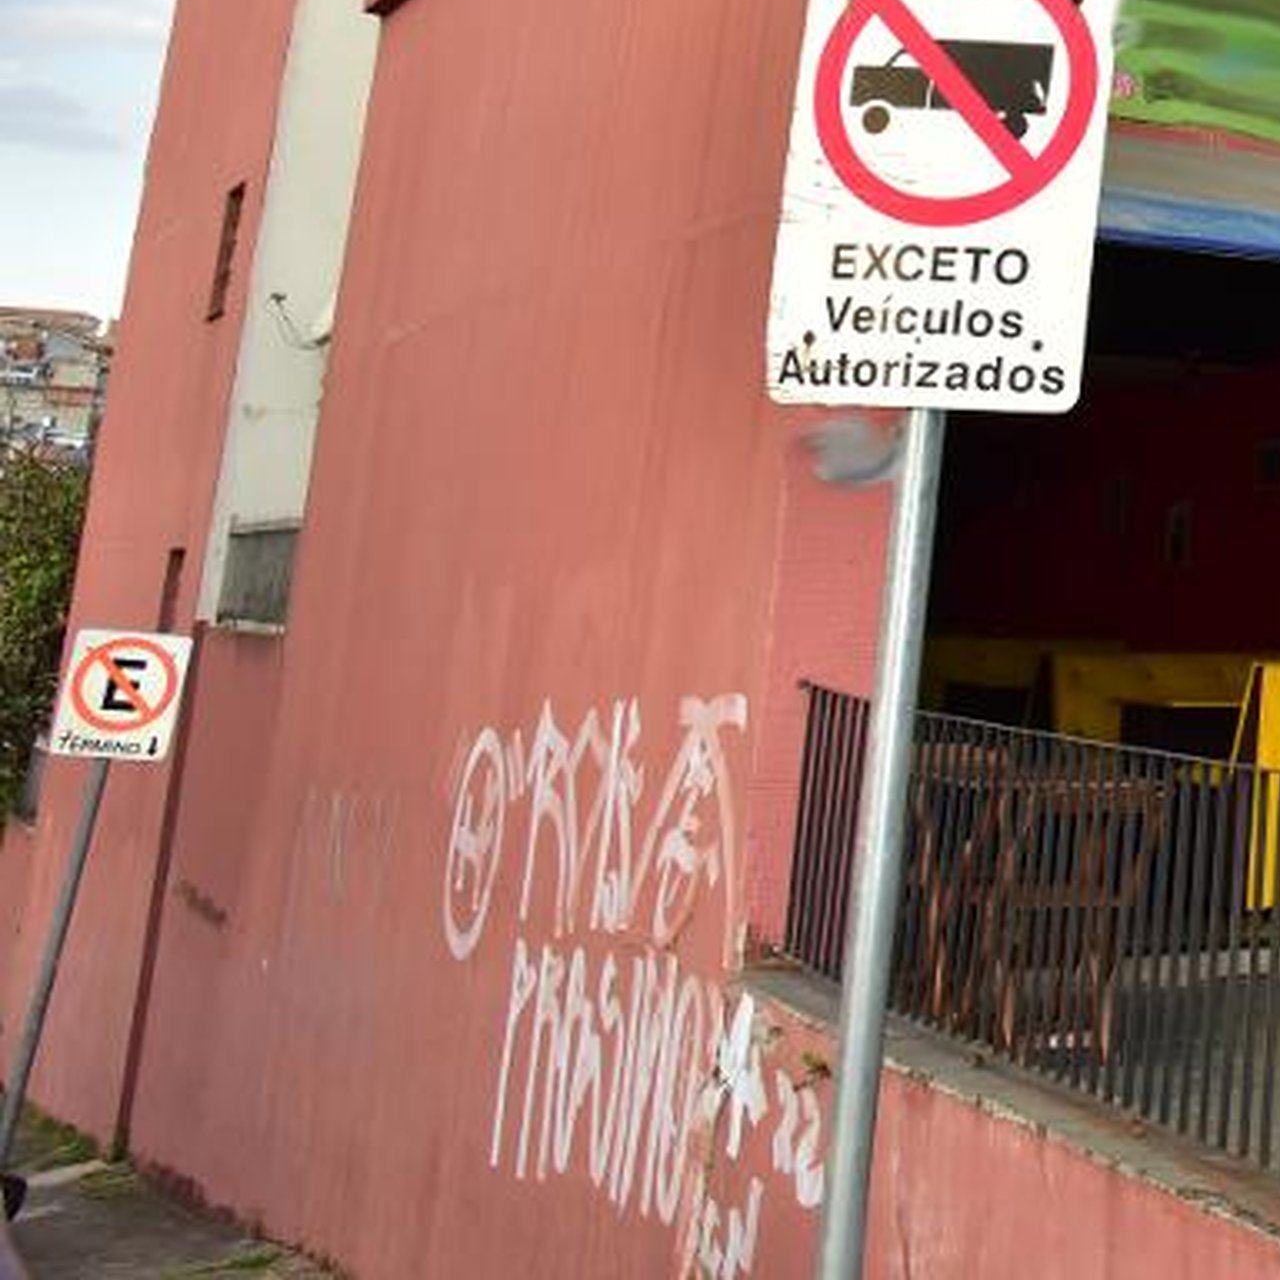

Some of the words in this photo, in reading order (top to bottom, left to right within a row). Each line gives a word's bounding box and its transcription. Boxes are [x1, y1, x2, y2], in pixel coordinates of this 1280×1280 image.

[831, 244, 1030, 285] EXCETO
[826, 295, 1024, 338] Veículos
[778, 349, 1066, 395] Autorizados
